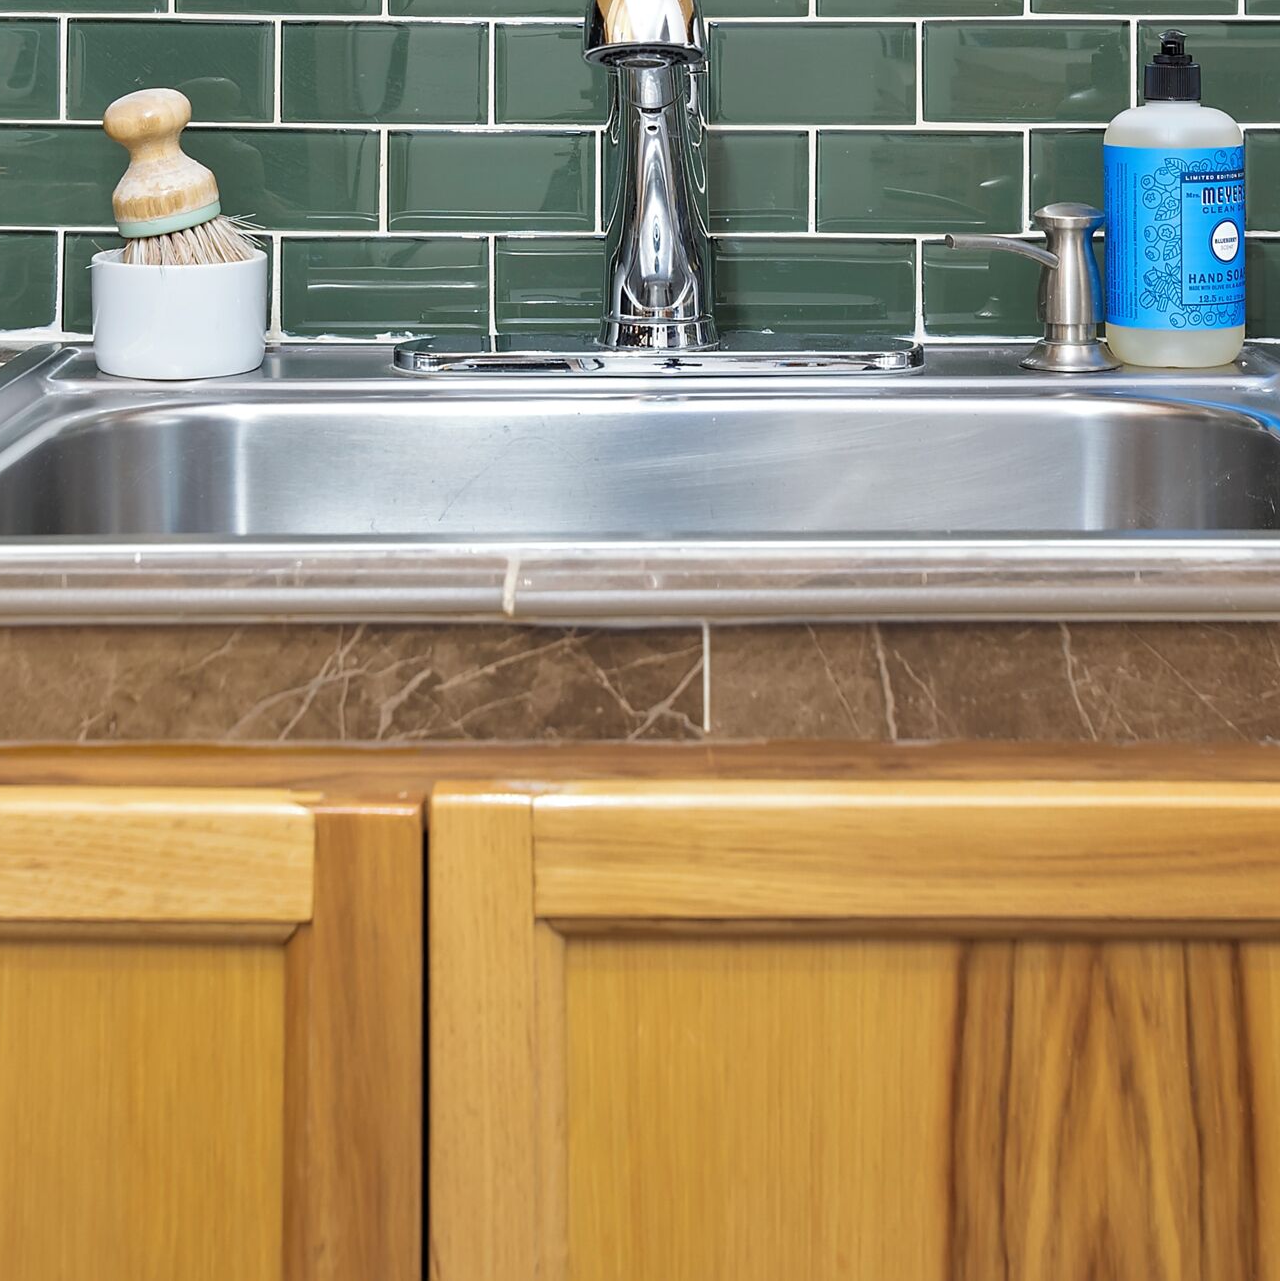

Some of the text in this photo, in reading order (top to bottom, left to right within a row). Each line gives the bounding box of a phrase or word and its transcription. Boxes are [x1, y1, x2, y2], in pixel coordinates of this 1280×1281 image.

[1202, 205, 1234, 214] CLEAN
[1188, 273, 1223, 284] HAND
[1199, 295, 1217, 303] 12.5
